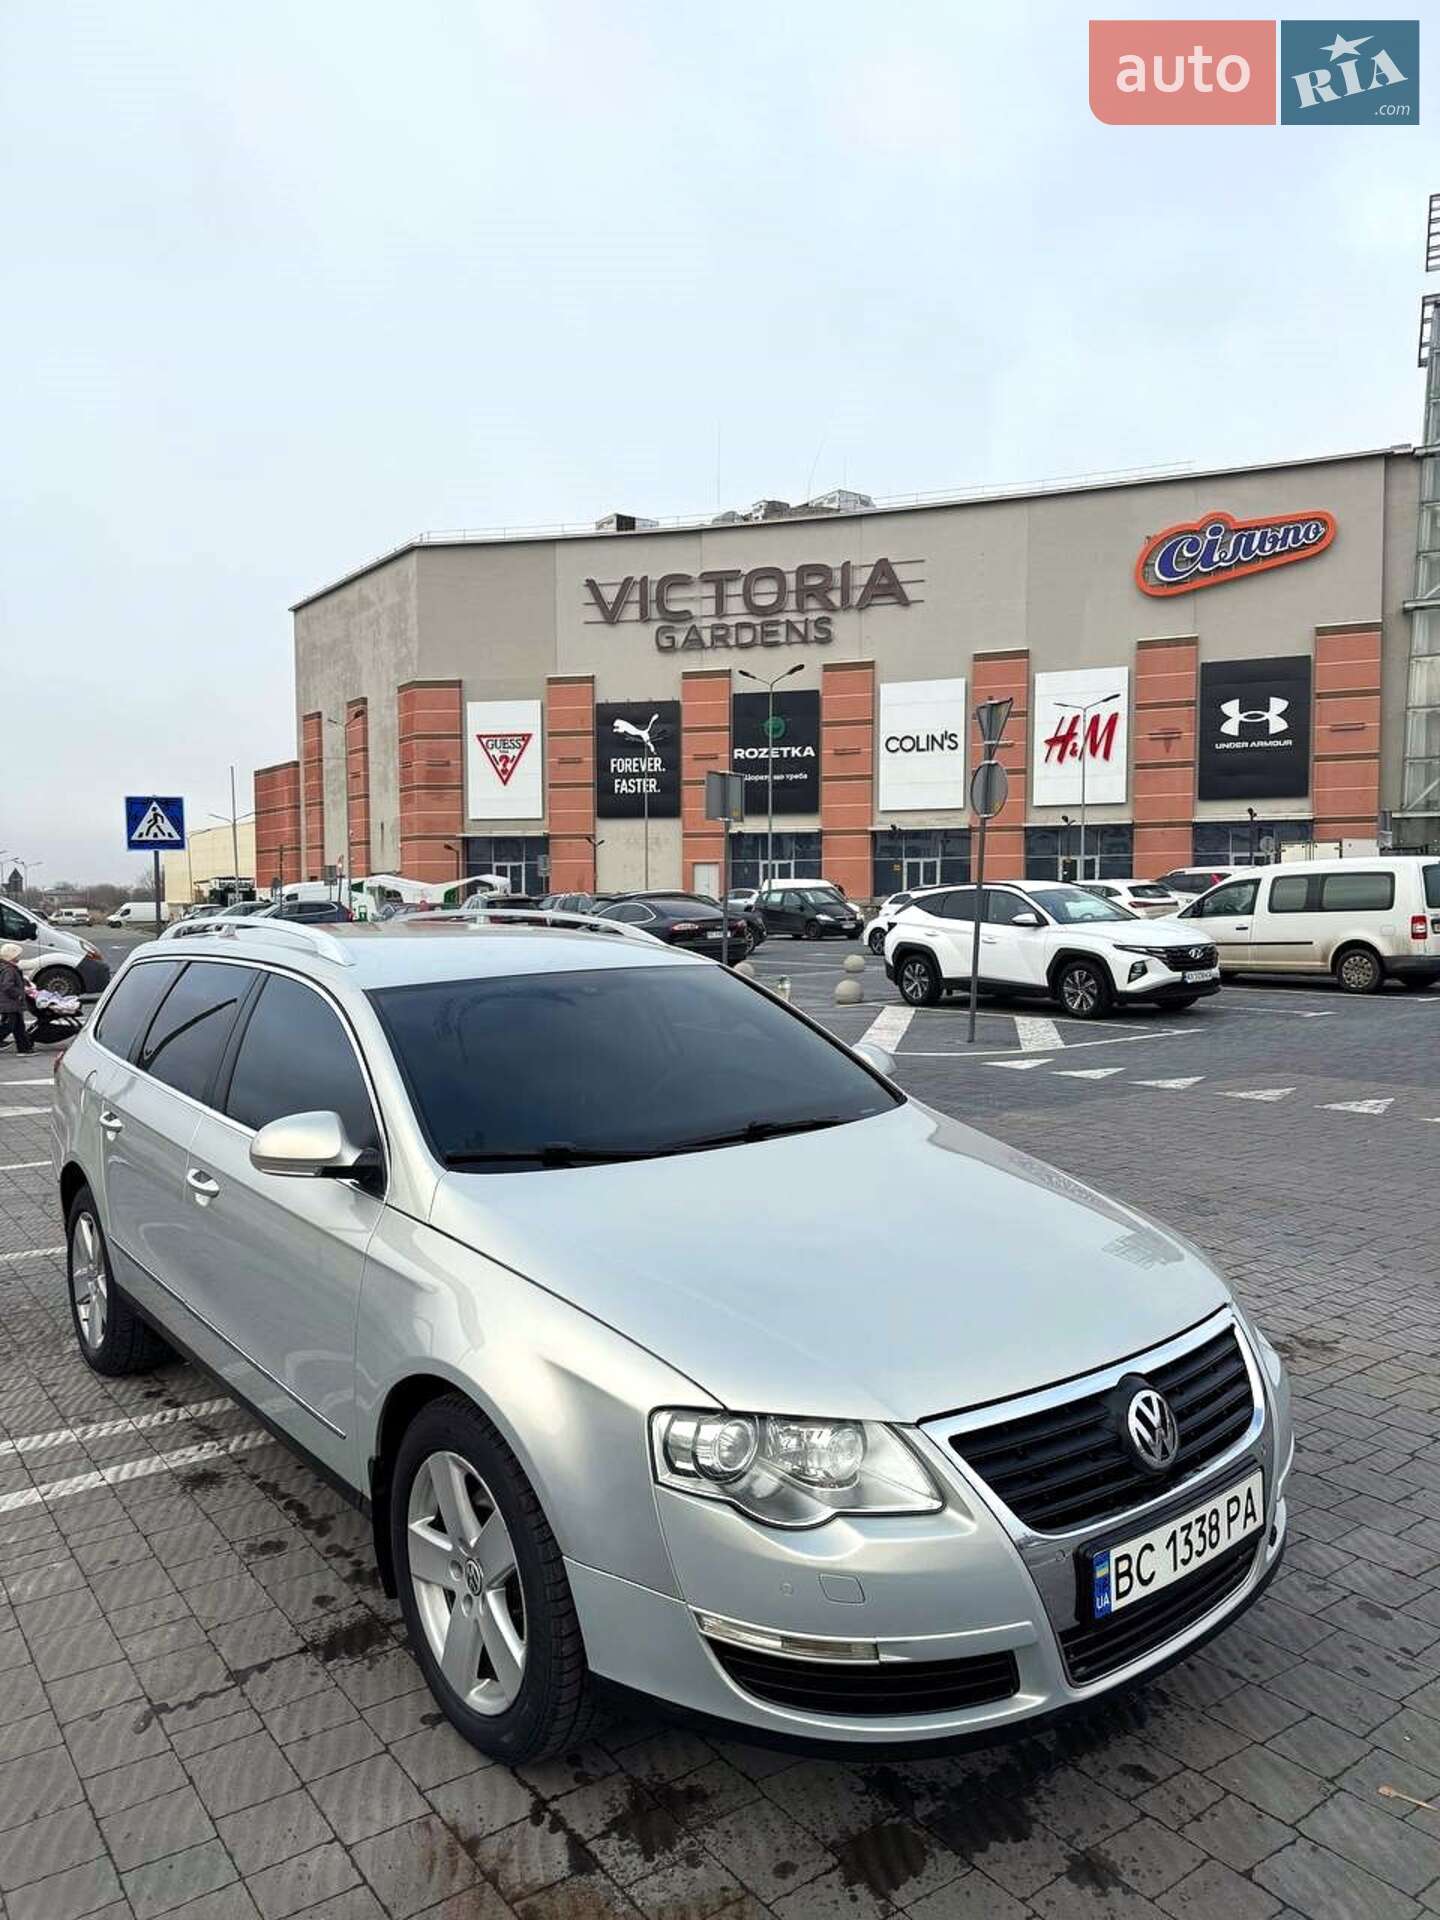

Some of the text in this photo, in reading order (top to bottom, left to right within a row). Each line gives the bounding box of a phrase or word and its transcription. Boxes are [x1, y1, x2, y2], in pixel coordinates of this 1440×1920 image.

[1154, 521, 1324, 582] Сільпо
[585, 558, 911, 624] VICTORIA
[655, 617, 833, 653] GARDENS
[485, 738, 522, 750] GUESS
[885, 730, 959, 753] COLIN'S
[1044, 712, 1119, 764] H&M
[1249, 739, 1292, 748] ARMOUR
[733, 746, 816, 760] ROZETKA
[610, 757, 666, 773] FOREVER.
[614, 778, 661, 794] FASTER.
[1114, 1487, 1257, 1601] BC 1338 PA
[1096, 1593, 1111, 1609] UA
